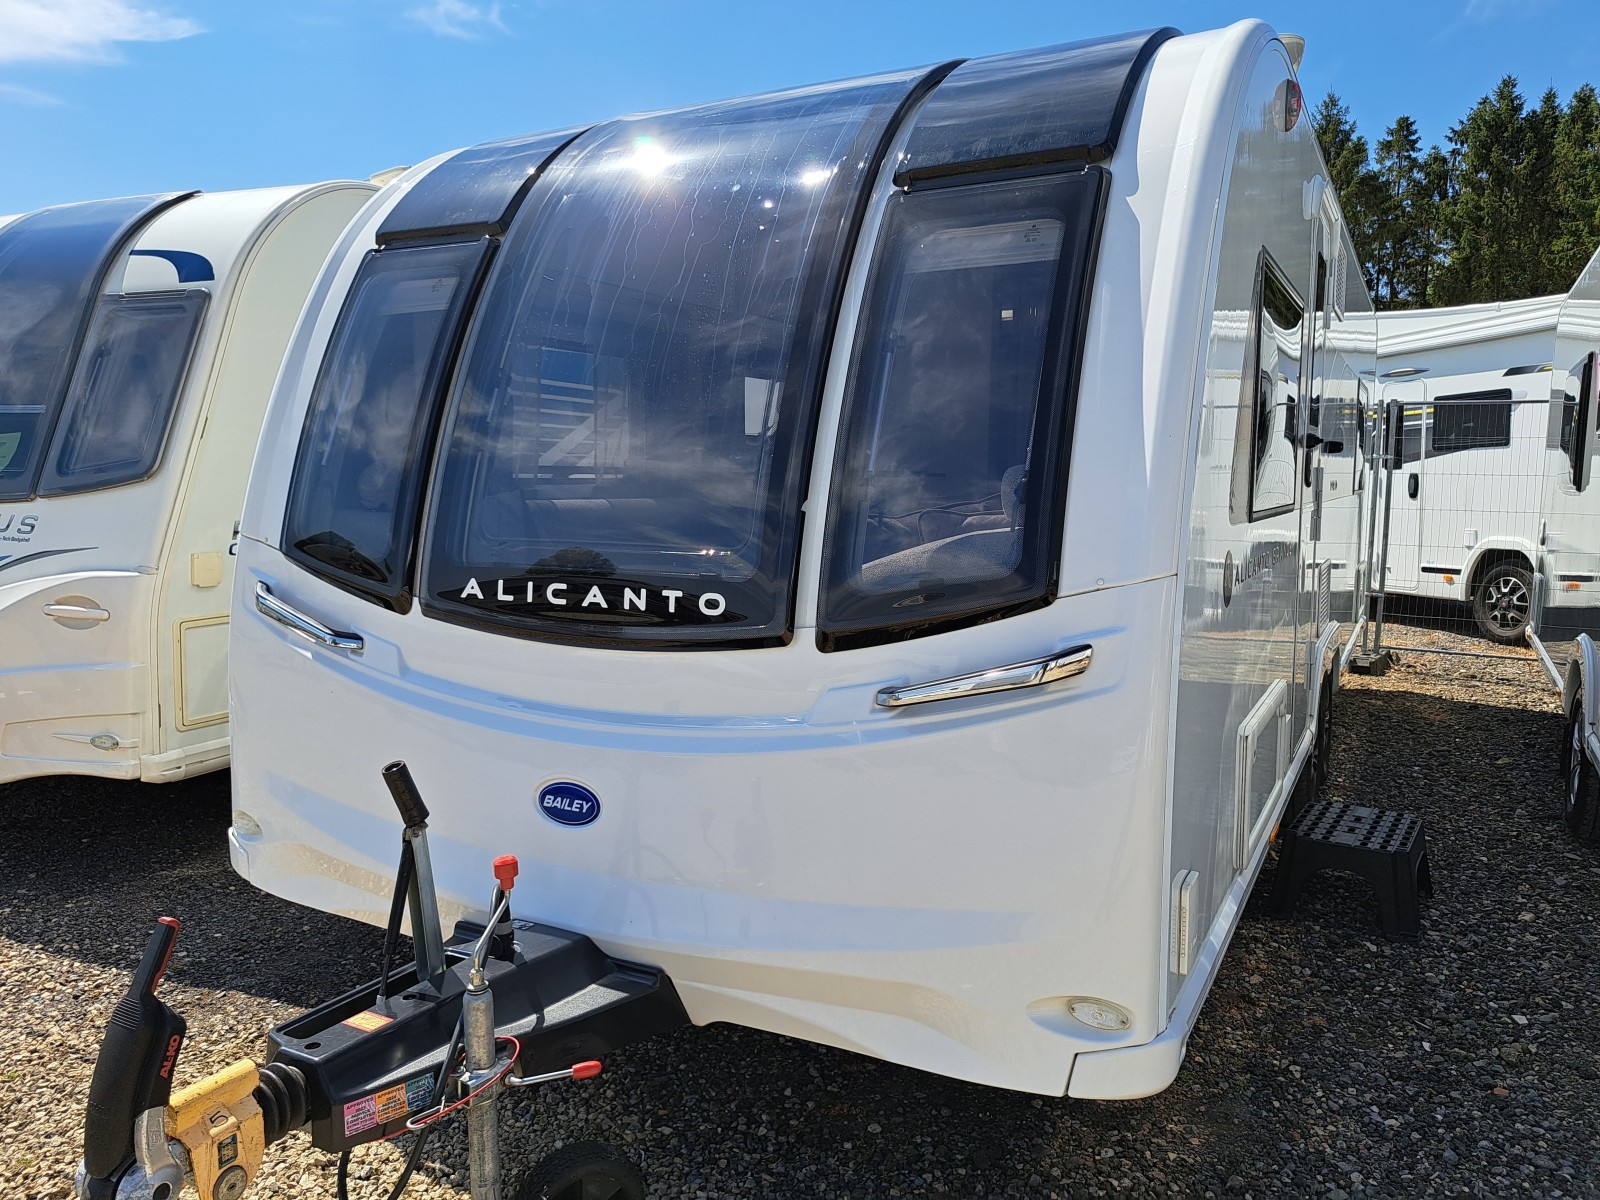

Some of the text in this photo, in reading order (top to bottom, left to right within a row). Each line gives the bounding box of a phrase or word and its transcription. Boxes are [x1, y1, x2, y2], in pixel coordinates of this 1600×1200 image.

[1234, 551, 1270, 587] ALICANTO
[460, 577, 727, 616] ALICANTO
[543, 794, 592, 814] BAILEY
